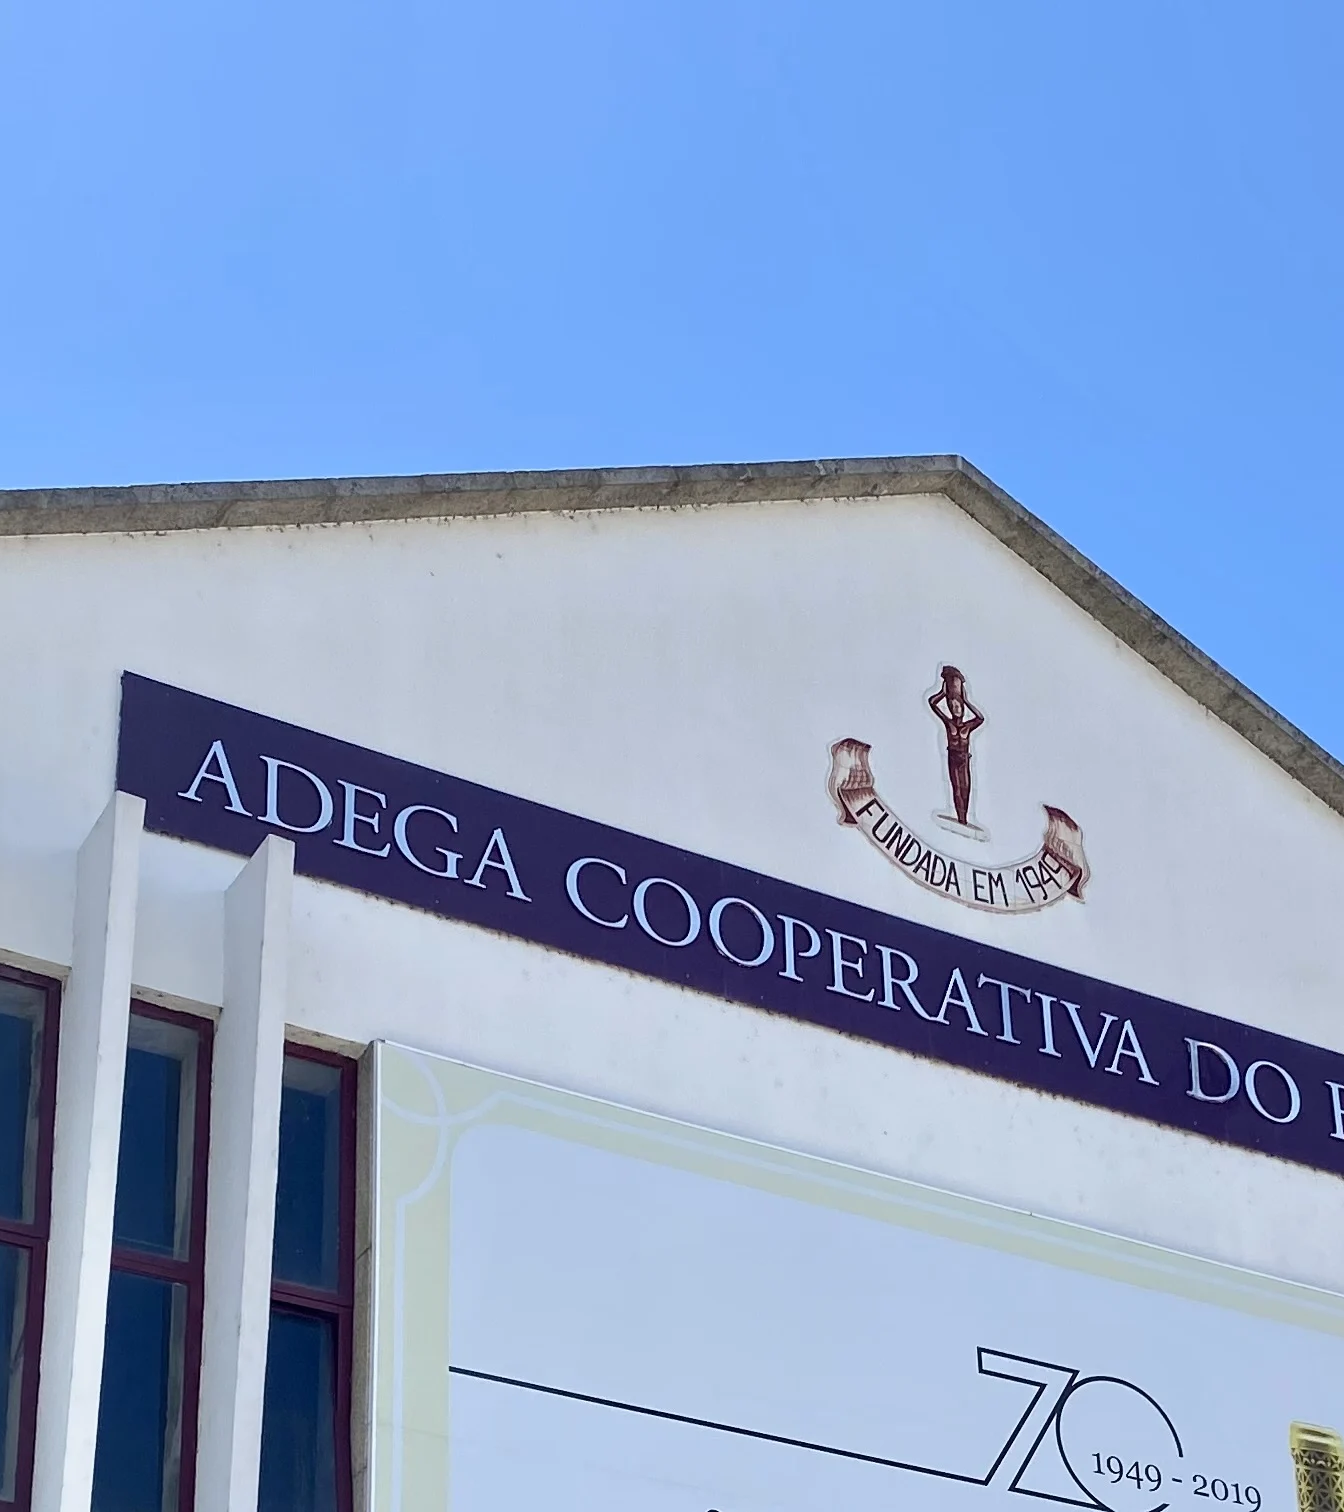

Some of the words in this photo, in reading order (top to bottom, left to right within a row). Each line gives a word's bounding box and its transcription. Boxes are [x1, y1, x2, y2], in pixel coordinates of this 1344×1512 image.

[856, 798, 961, 897] FUNDADA
[972, 869, 1009, 907] EM
[1016, 850, 1073, 903] 1949
[178, 739, 532, 902] ADEGA
[565, 856, 1159, 1086] COOPERATIVA
[1184, 1037, 1302, 1124] DO
[1091, 1452, 1163, 1492] 1949
